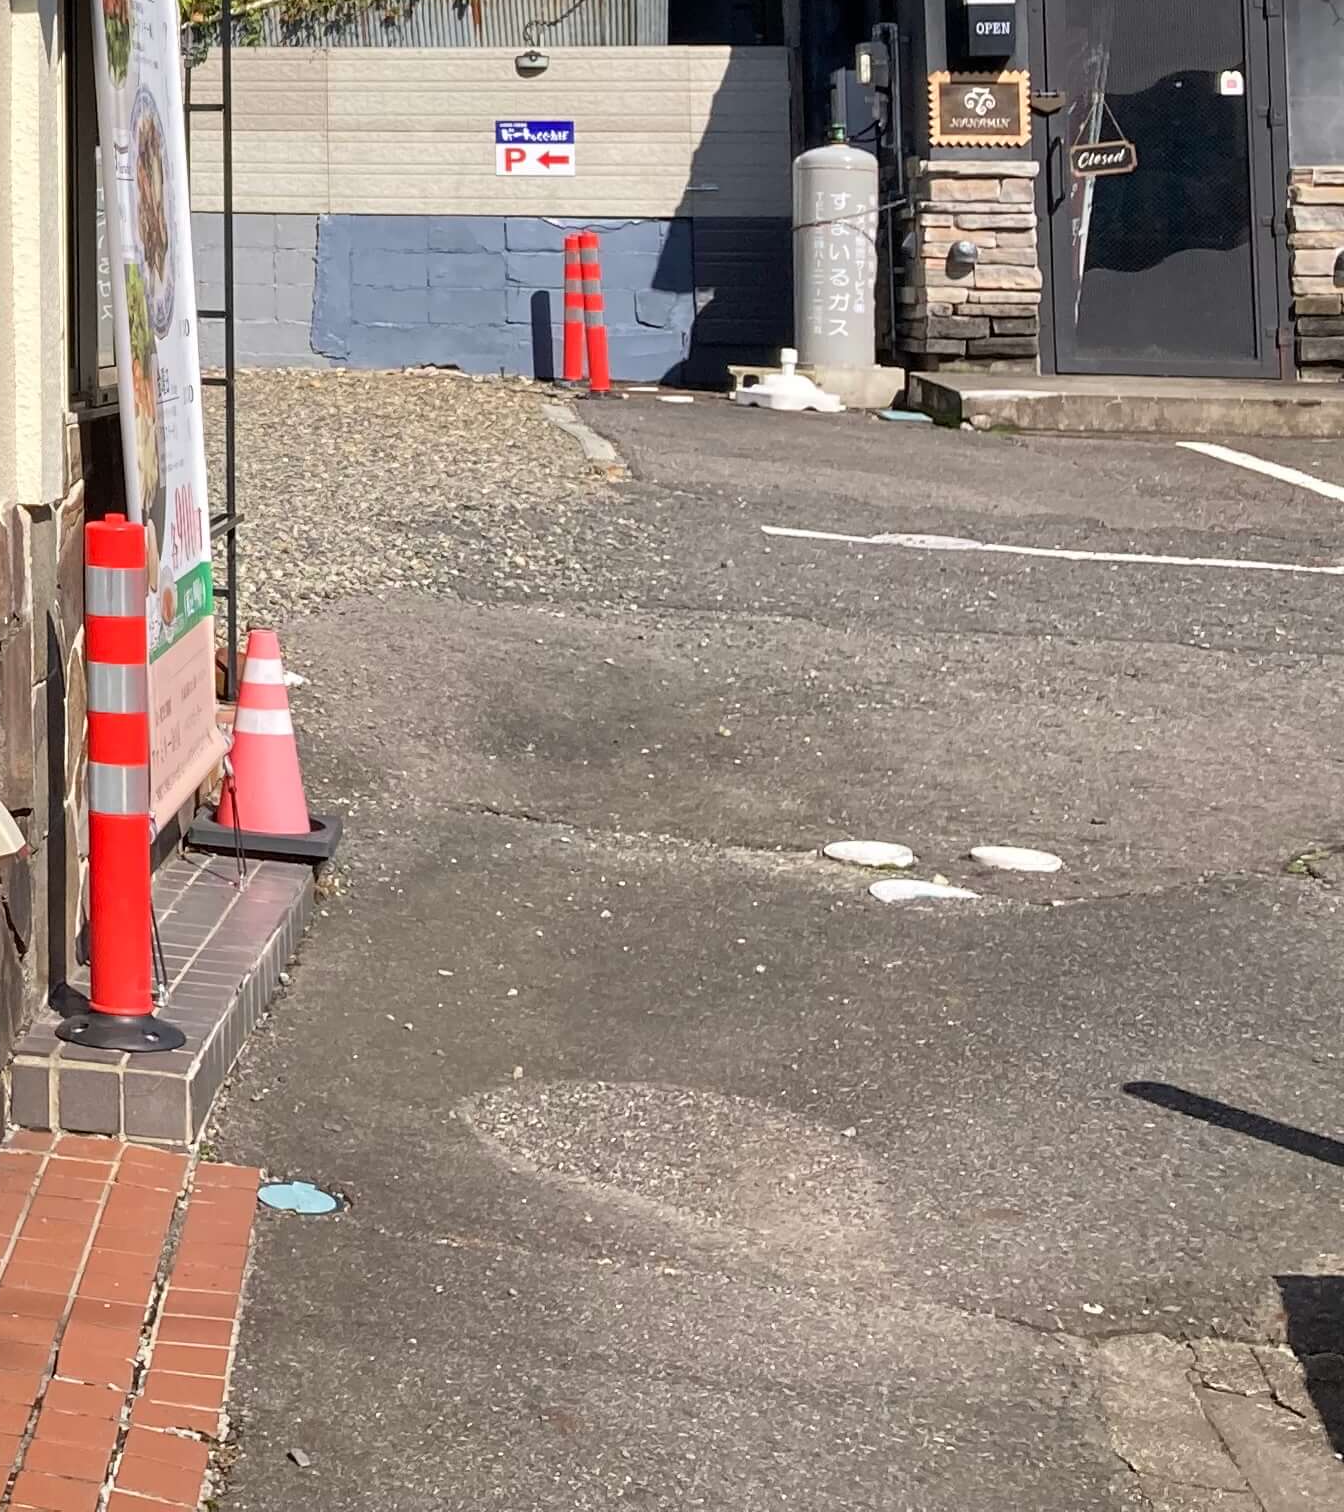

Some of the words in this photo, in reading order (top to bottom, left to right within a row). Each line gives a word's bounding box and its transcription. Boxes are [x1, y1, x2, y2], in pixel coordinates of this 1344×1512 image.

[975, 22, 1011, 36] OPEN
[504, 147, 527, 172] P
[1077, 147, 1125, 170] Closed
